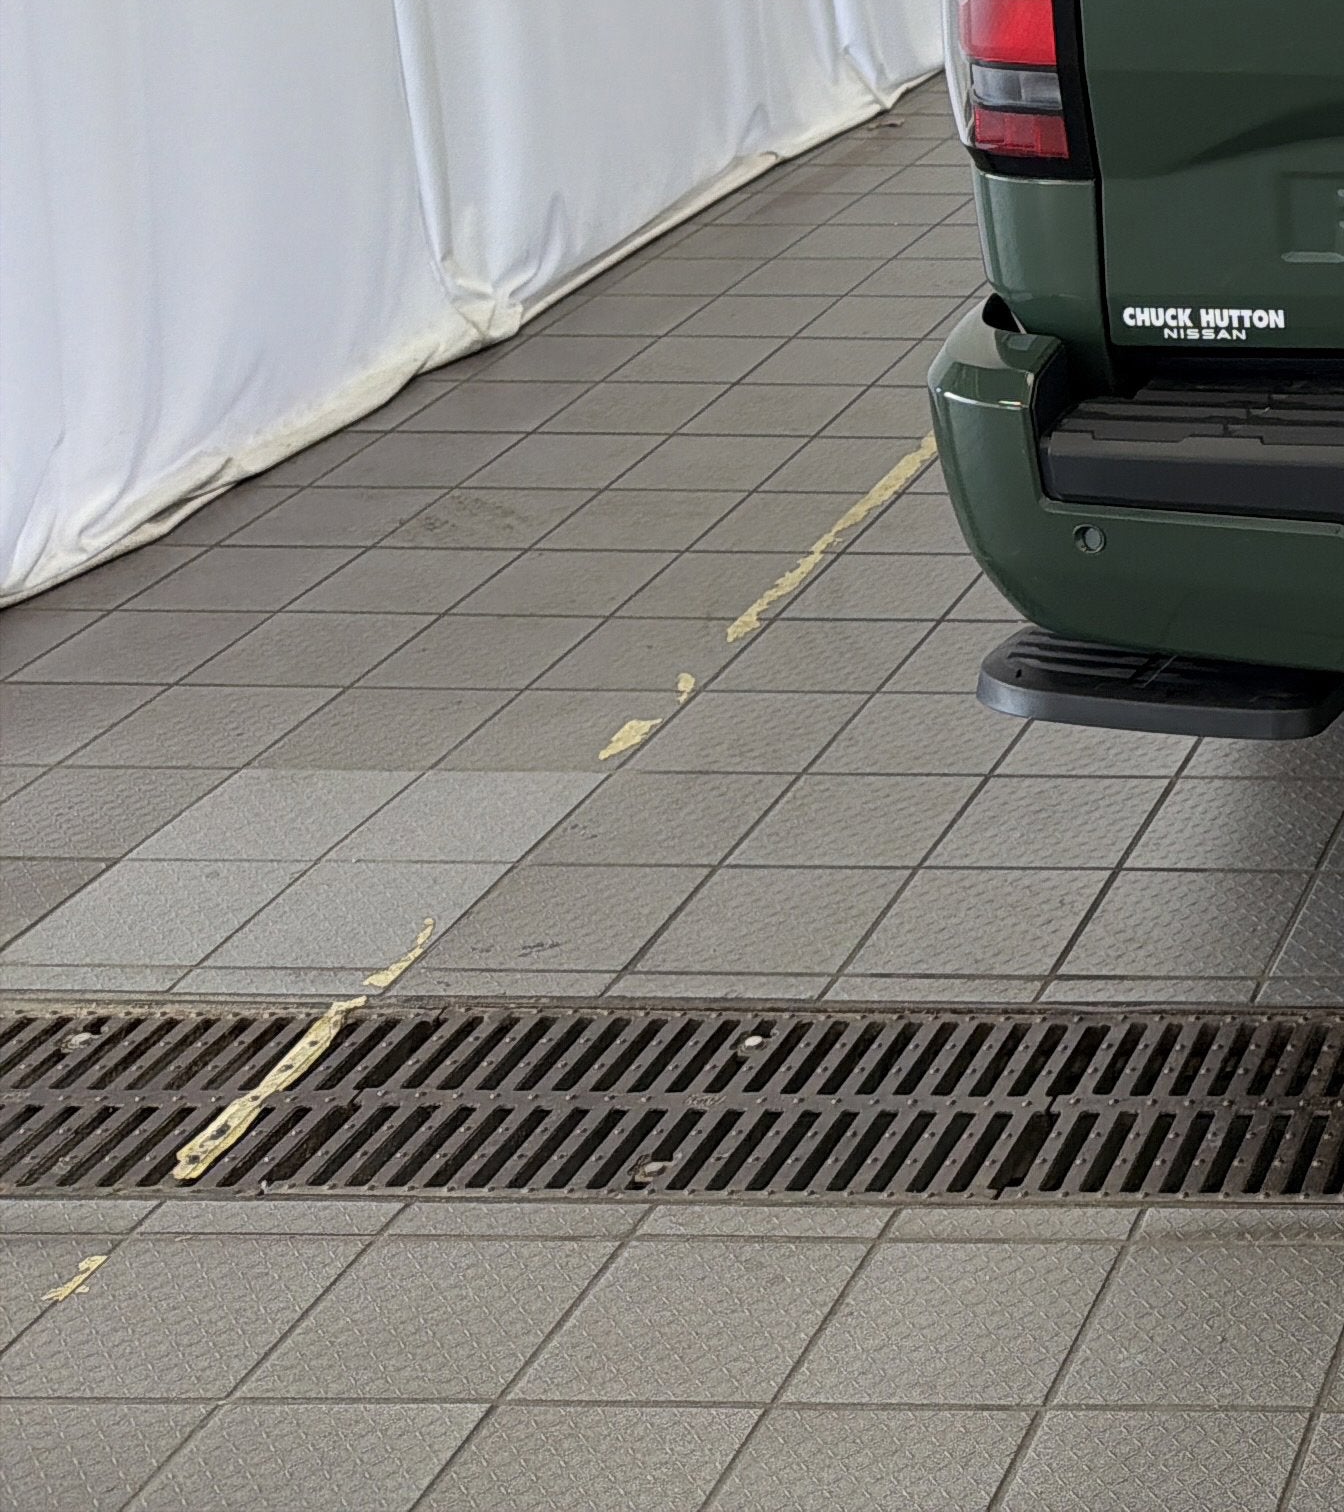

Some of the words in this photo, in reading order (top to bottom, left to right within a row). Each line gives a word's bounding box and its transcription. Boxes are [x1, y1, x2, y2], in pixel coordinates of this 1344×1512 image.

[1123, 307, 1193, 327] CHUCK
[1200, 309, 1285, 328] HUTTON
[1164, 328, 1247, 340] NISSAN
